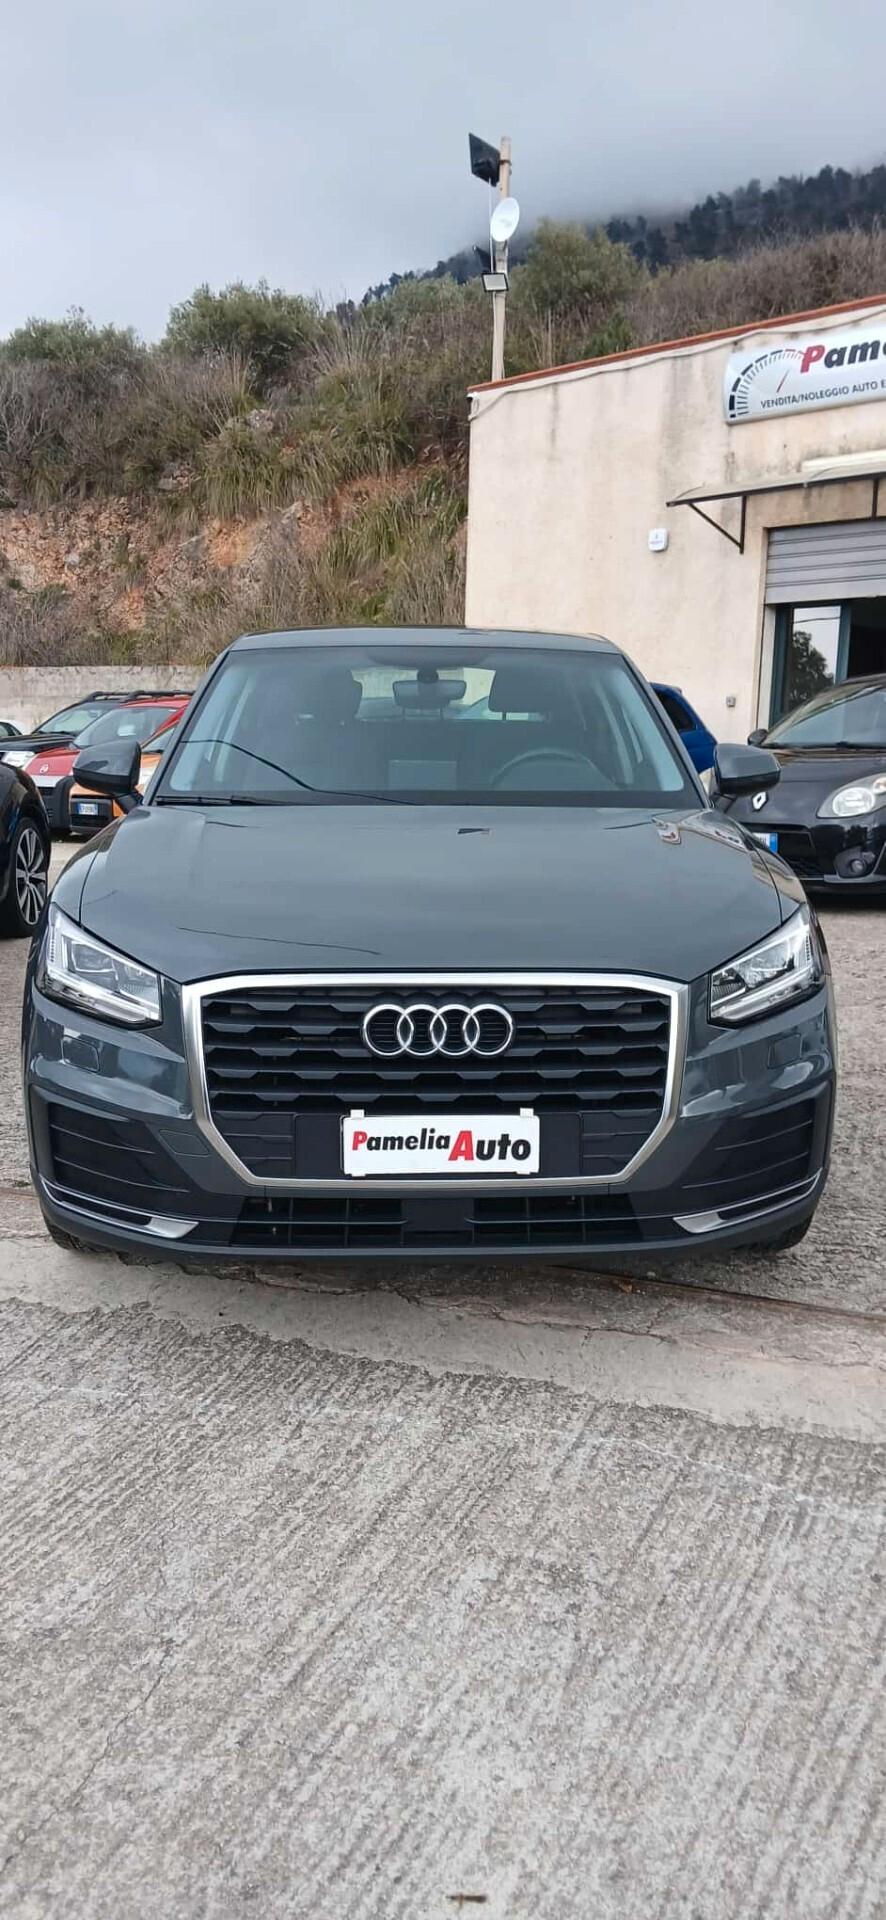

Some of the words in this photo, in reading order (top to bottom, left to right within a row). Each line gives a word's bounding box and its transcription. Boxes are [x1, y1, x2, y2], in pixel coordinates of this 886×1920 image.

[800, 340, 886, 373] Pam
[760, 386, 849, 409] VENDITA/NOLEGGIO
[852, 381, 878, 393] AUTO
